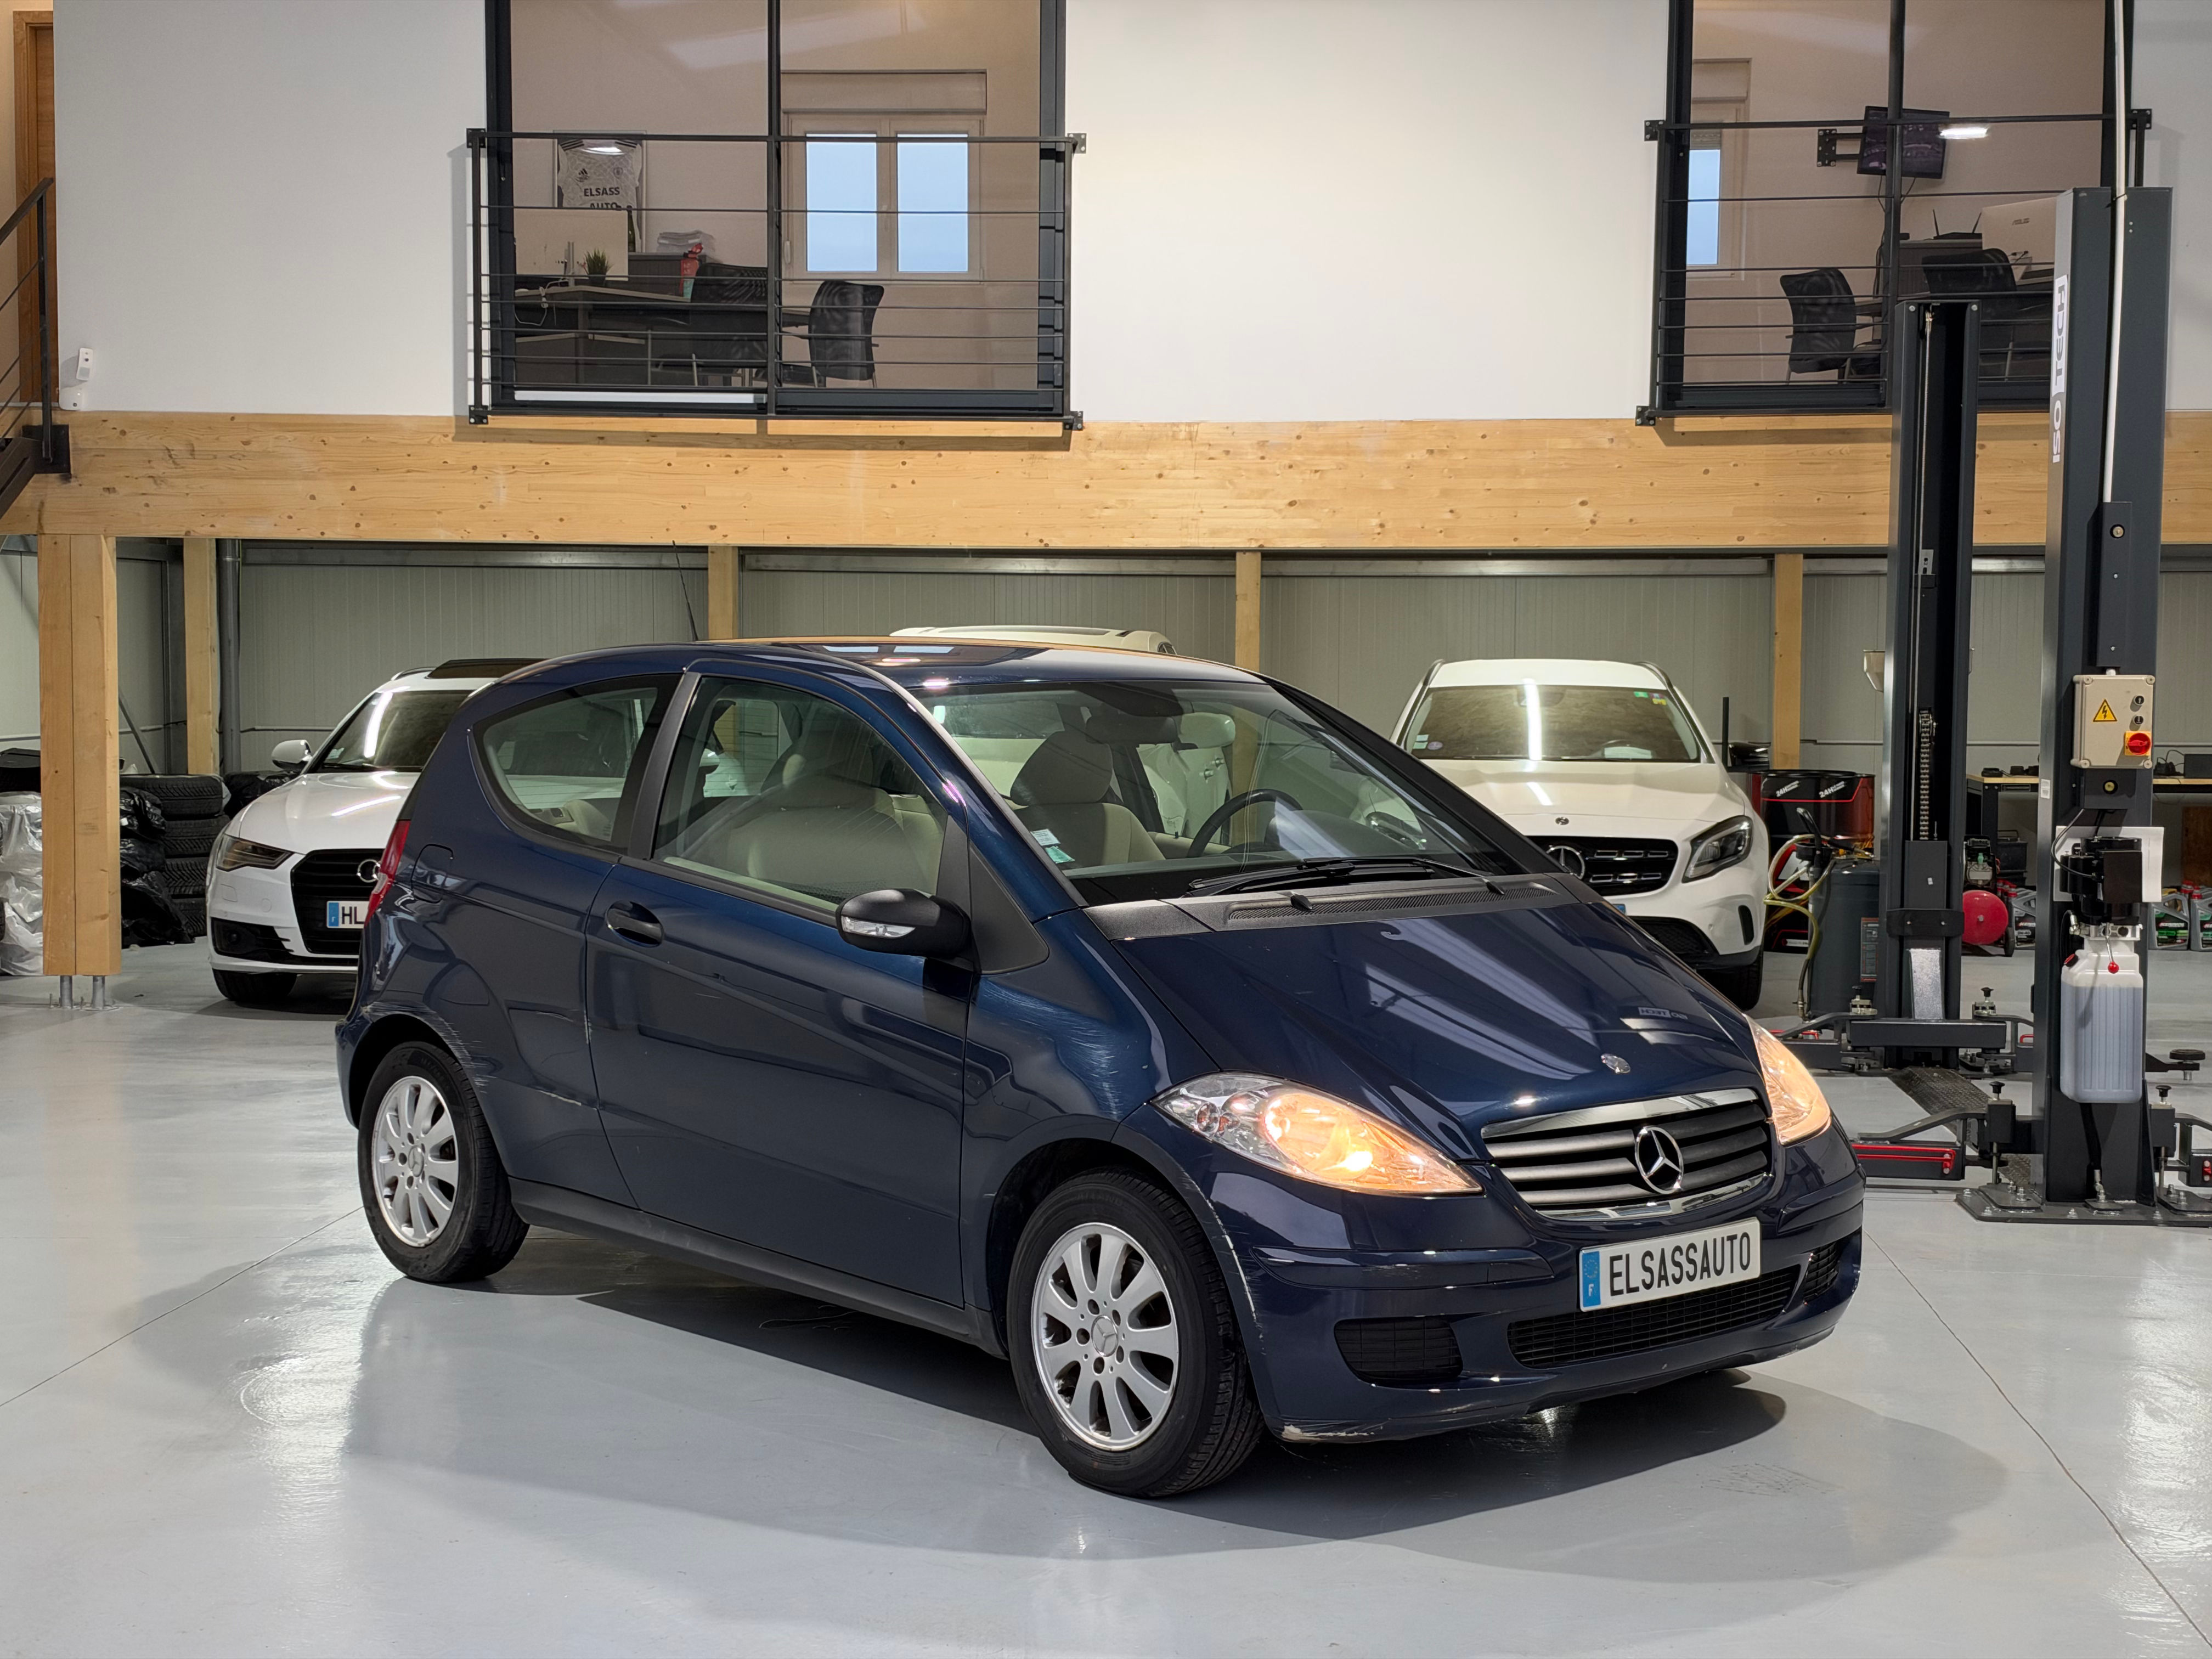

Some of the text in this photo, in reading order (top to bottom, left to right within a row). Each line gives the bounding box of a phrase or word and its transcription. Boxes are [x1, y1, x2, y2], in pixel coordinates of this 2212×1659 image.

[584, 187, 620, 196] ELSASS
[2052, 284, 2066, 464] ISO TECH
[1819, 787, 1834, 798] 24H
[1609, 1232, 1751, 1296] ELSASSAUTO
[1588, 1283, 1594, 1296] F
